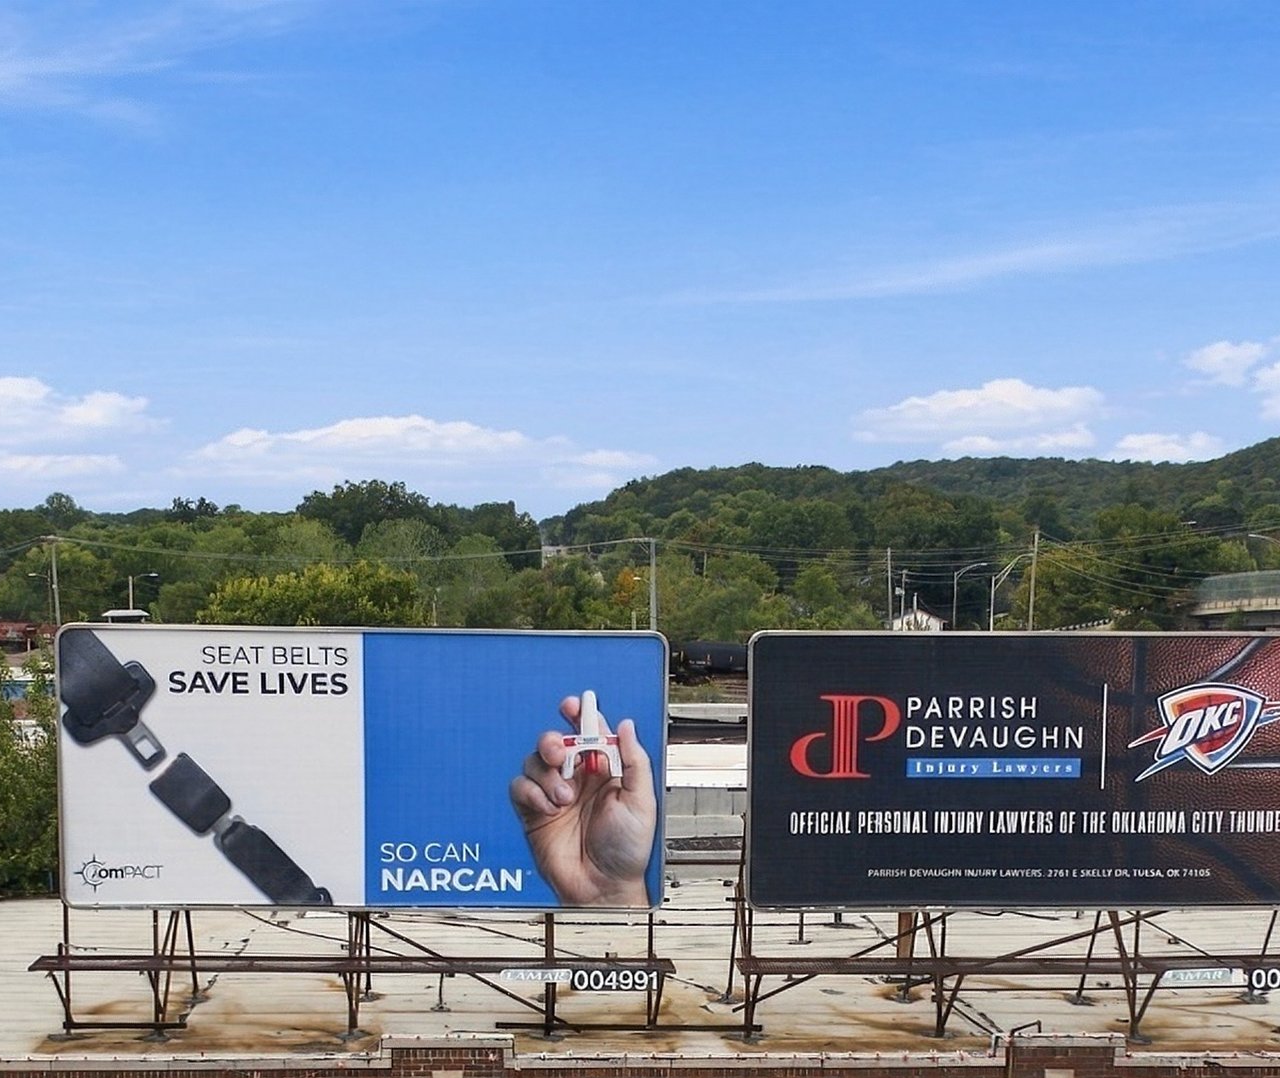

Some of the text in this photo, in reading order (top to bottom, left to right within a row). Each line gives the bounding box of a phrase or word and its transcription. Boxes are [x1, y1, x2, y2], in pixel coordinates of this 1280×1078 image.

[201, 646, 348, 666] SEAT BELTS
[168, 672, 348, 695] SAVE LIVES
[906, 696, 1037, 720] PARRISH
[906, 725, 1084, 749] DEVAUGHN
[1160, 700, 1242, 755] OKC
[915, 761, 1074, 775] Injury Lawyers
[790, 810, 851, 834] OFFICIAL
[858, 810, 929, 834] PERSONAL
[934, 810, 984, 834] INJURY
[989, 810, 1054, 834] LAWYERS
[1059, 810, 1076, 834] OF
[1082, 810, 1106, 833] THE
[1112, 810, 1186, 833] OKLAHOMA
[1192, 810, 1223, 833] CITY
[380, 843, 480, 863] SO CAN
[380, 868, 522, 892] NARCAN
[868, 868, 907, 877] PARRISH
[909, 868, 962, 877] DEVAUGHN
[964, 868, 997, 877] INJURY
[1072, 868, 1078, 877] E
[1080, 868, 1112, 877] SKELLY
[1167, 868, 1180, 877] OK
[1182, 868, 1210, 877] 74105
[506, 970, 658, 990] LAMAR 004991
